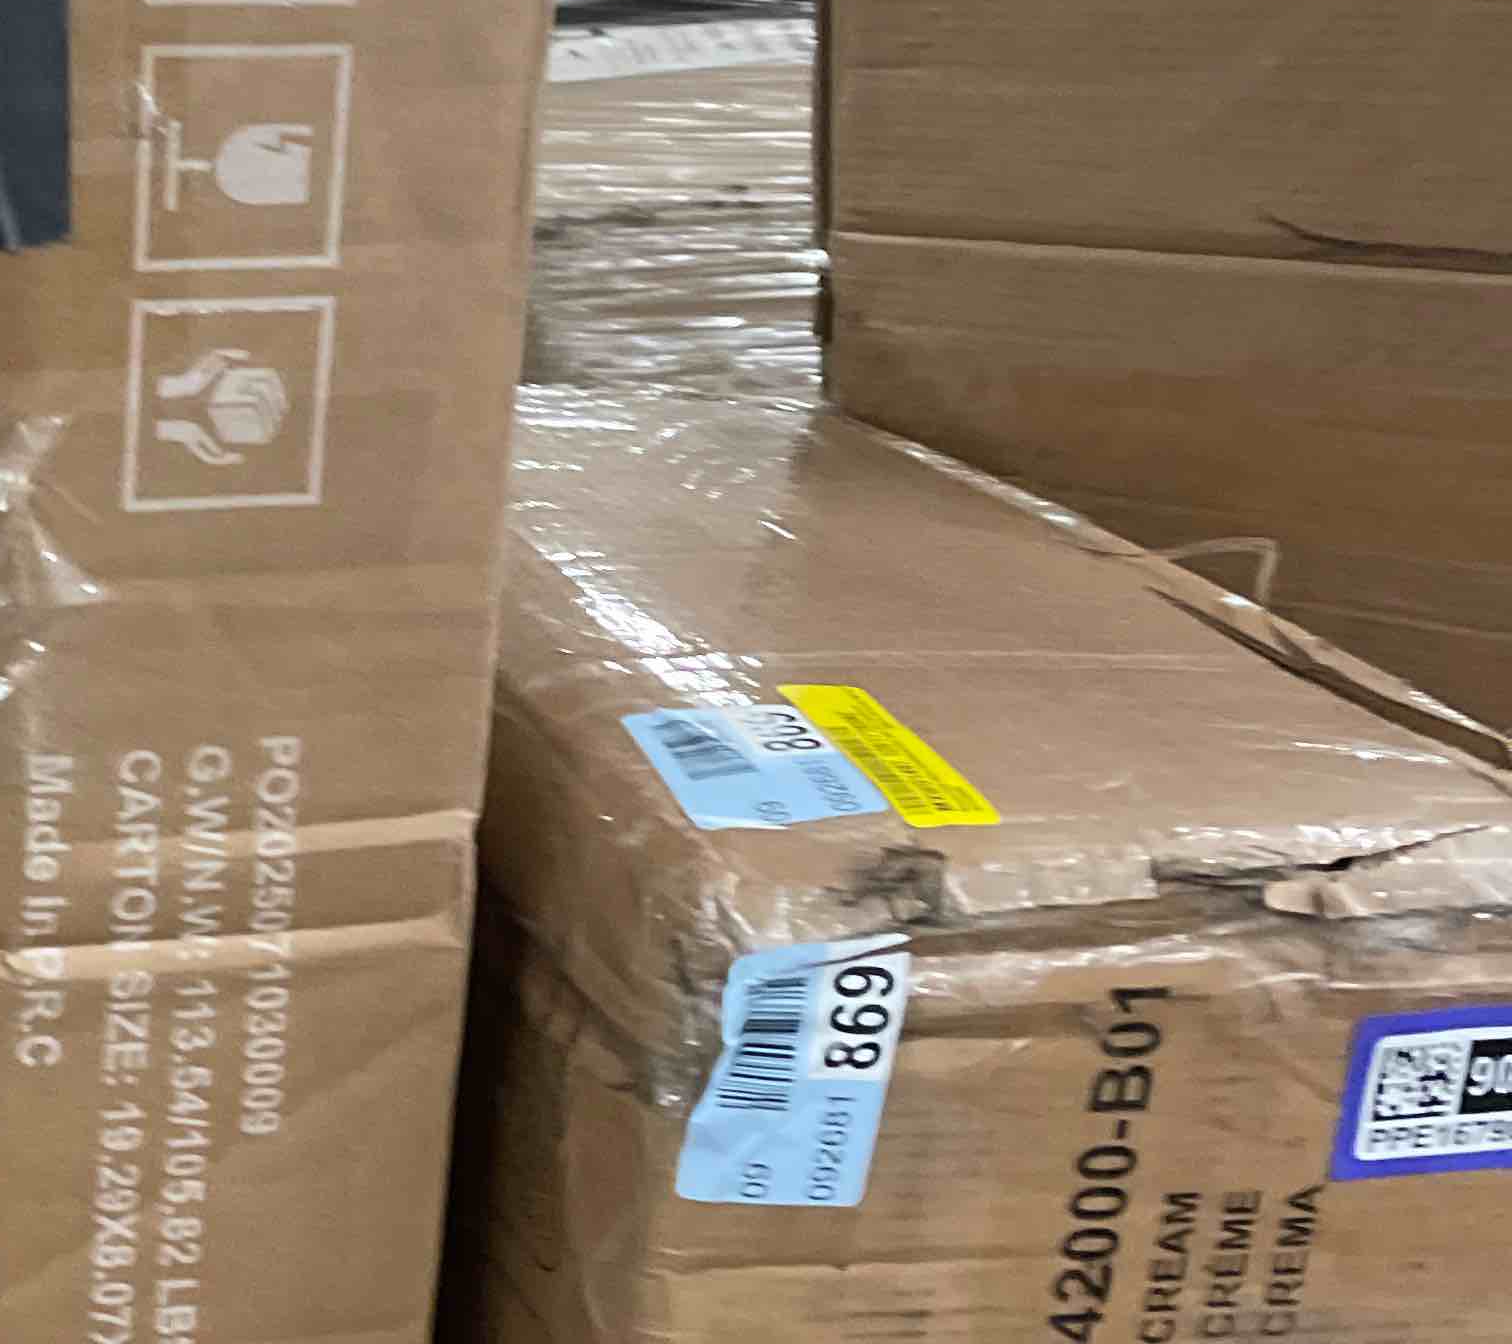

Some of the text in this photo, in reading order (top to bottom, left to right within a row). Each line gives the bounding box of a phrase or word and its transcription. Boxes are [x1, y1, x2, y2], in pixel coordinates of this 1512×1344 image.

[21, 753, 73, 882] Made
[108, 749, 162, 953] CARTON
[21, 896, 71, 936] In
[824, 965, 895, 1072] 869
[740, 1161, 775, 1200] 09
[807, 1094, 859, 1202] 092681
[1262, 1183, 1325, 1338] CREMA
